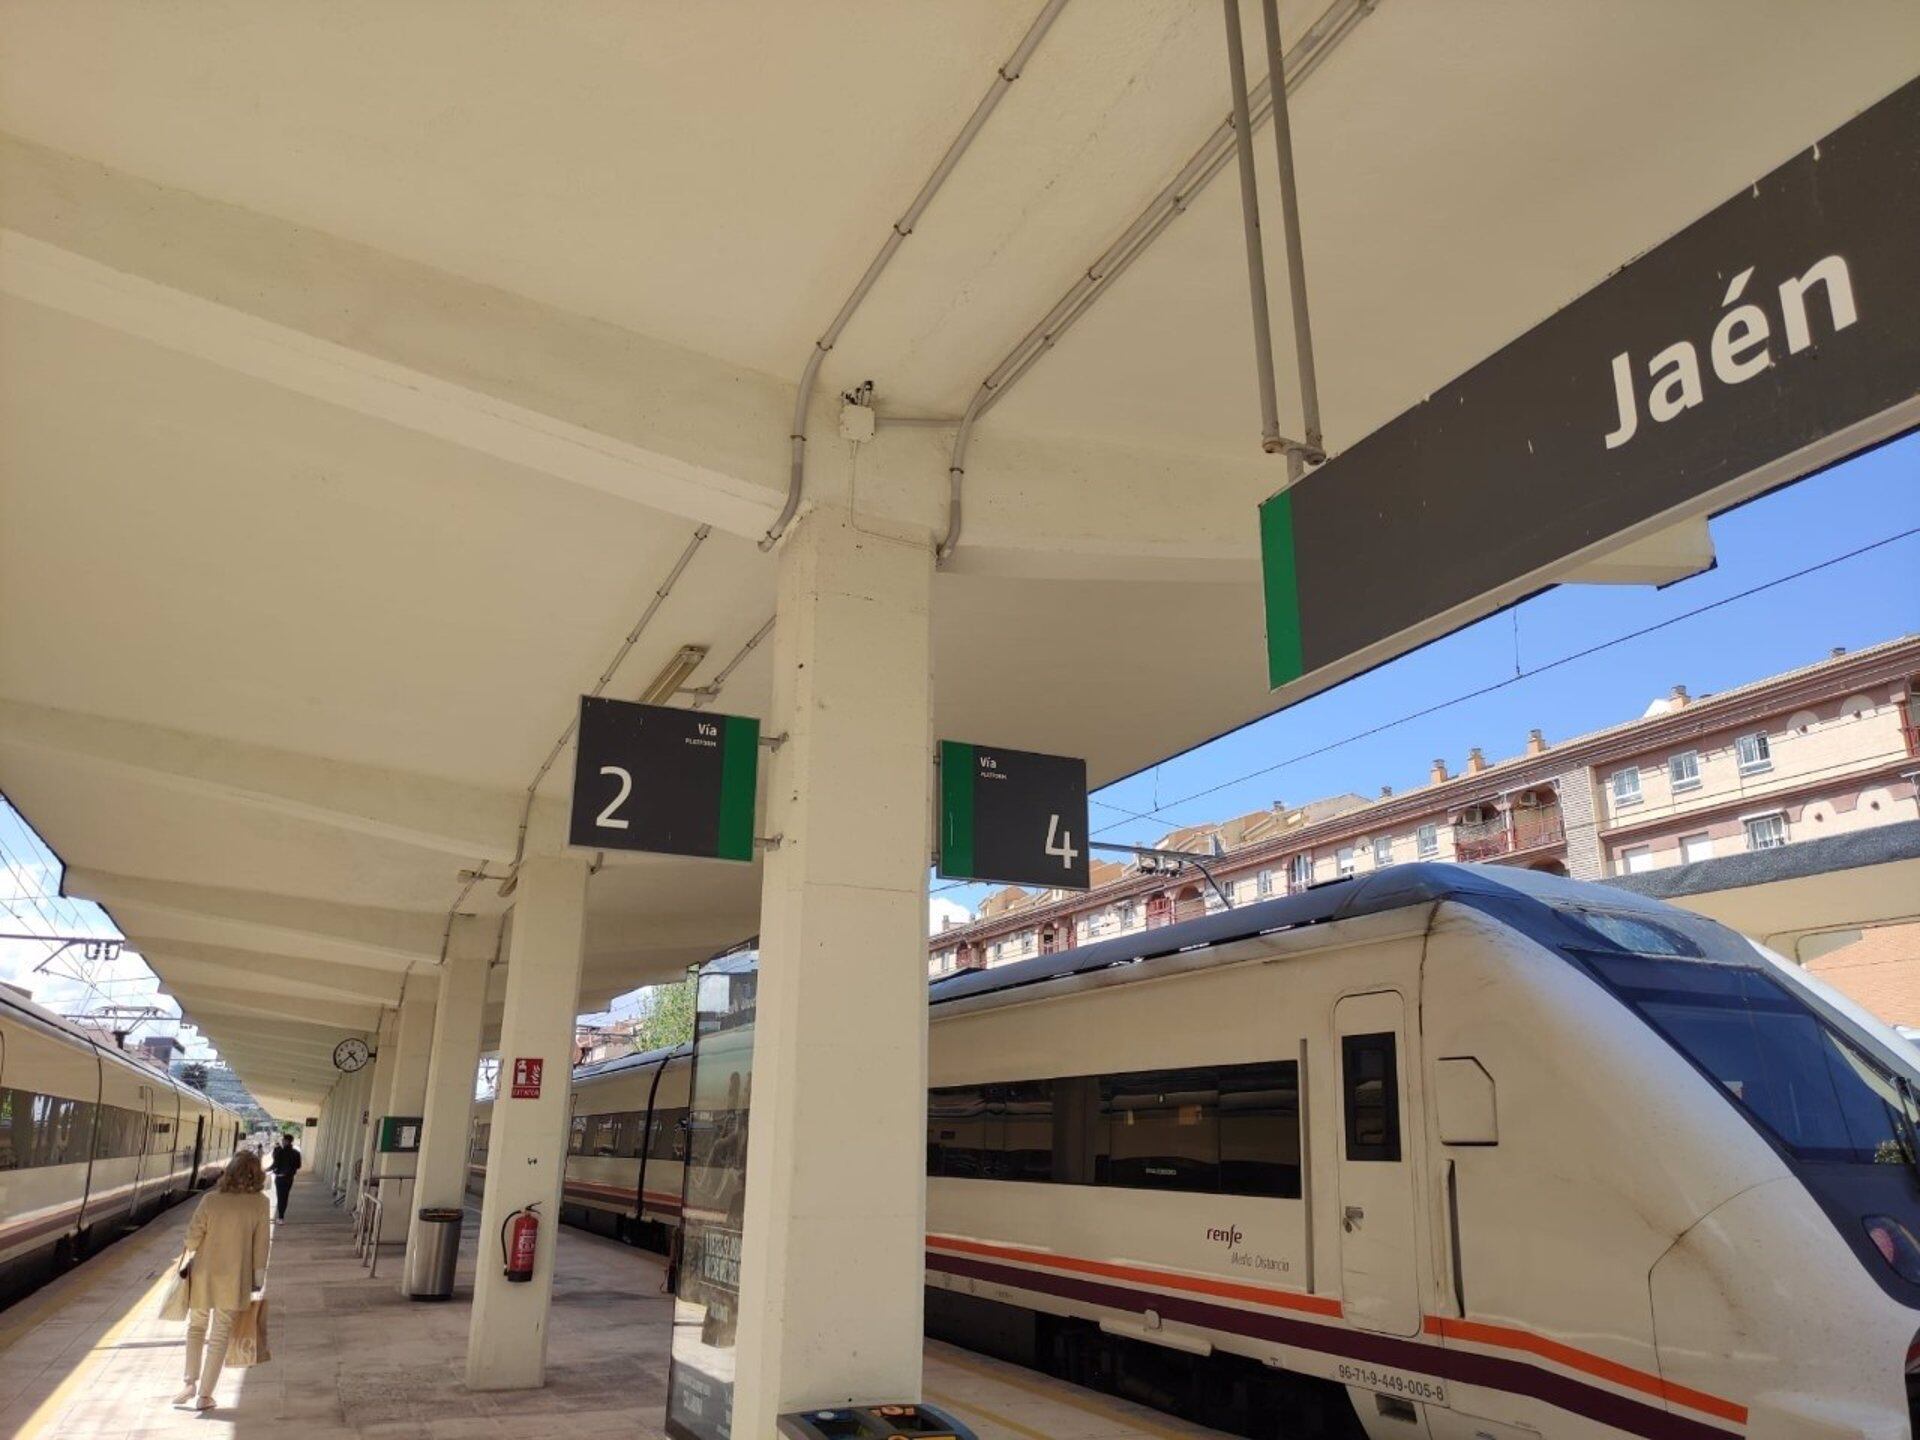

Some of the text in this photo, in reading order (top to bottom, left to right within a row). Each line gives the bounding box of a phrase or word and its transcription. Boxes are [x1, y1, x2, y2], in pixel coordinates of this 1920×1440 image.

[1605, 255, 1858, 450] Jaén
[698, 722, 718, 736] Vía
[980, 756, 997, 769] Vía
[595, 766, 633, 829] 2
[1044, 814, 1078, 869] 4
[1206, 1224, 1243, 1250] renfe
[1338, 1364, 1444, 1401] 96-71-9-449-005-8
